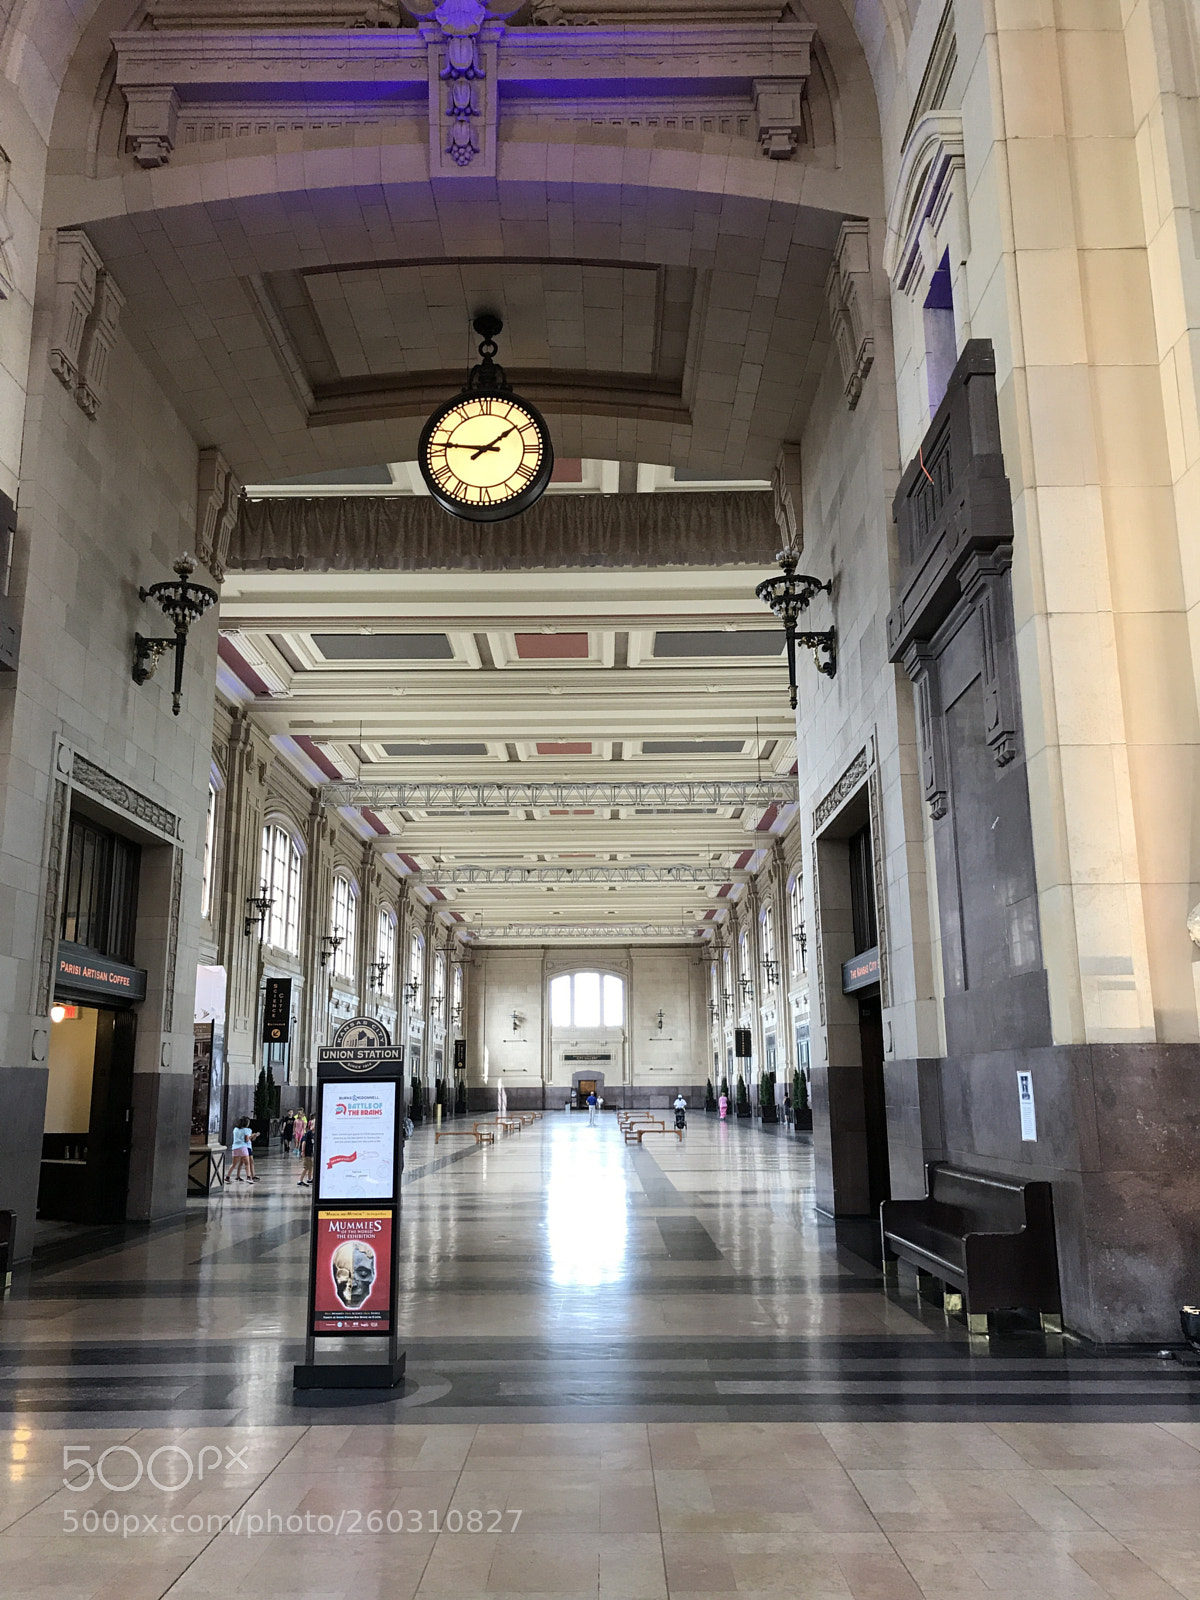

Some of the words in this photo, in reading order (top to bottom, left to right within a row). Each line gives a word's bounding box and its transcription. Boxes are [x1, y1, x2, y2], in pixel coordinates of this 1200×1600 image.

[60, 960, 82, 976] PARISI
[82, 966, 108, 982] ARTISAN
[108, 972, 131, 987] COFFEE
[337, 1021, 368, 1043] KANSAS
[371, 1024, 385, 1043] CITY
[322, 1050, 354, 1059] UNION
[357, 1049, 399, 1058] STATION
[328, 1219, 382, 1232] MUMMIES
